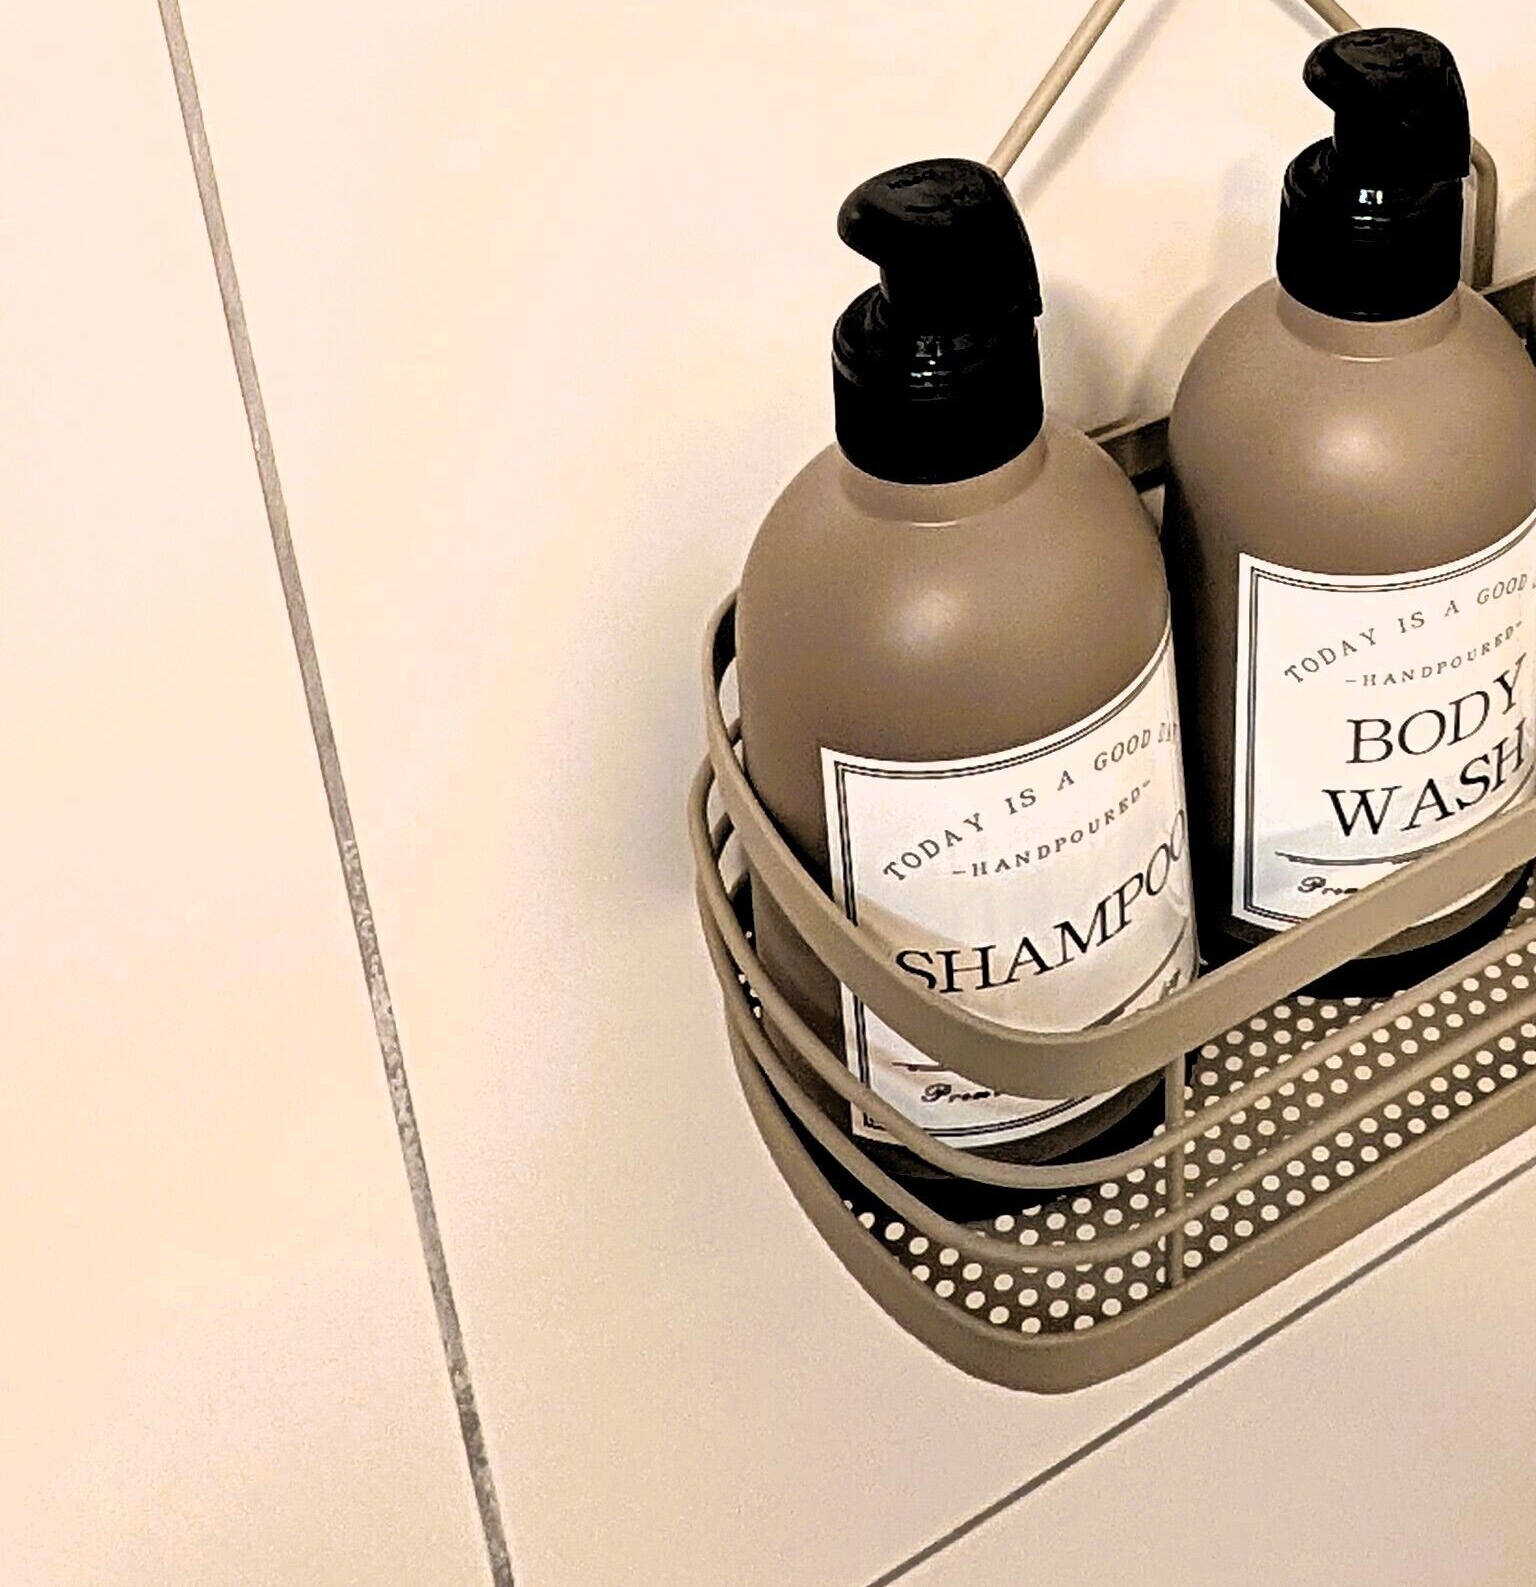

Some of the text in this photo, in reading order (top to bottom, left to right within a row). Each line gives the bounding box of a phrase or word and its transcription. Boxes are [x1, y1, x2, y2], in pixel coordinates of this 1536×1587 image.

[1283, 627, 1379, 685] TODAY
[1396, 611, 1426, 635] IS
[1444, 599, 1461, 618] A
[1476, 573, 1528, 605] GOOD
[1344, 651, 1528, 765] BODY
[882, 812, 986, 882] TODAY
[1004, 788, 1037, 816] IS
[1056, 769, 1075, 791] A
[1093, 727, 1152, 772] GOOD
[1321, 716, 1528, 838] WASH
[894, 808, 1186, 995] SHAMPOO
